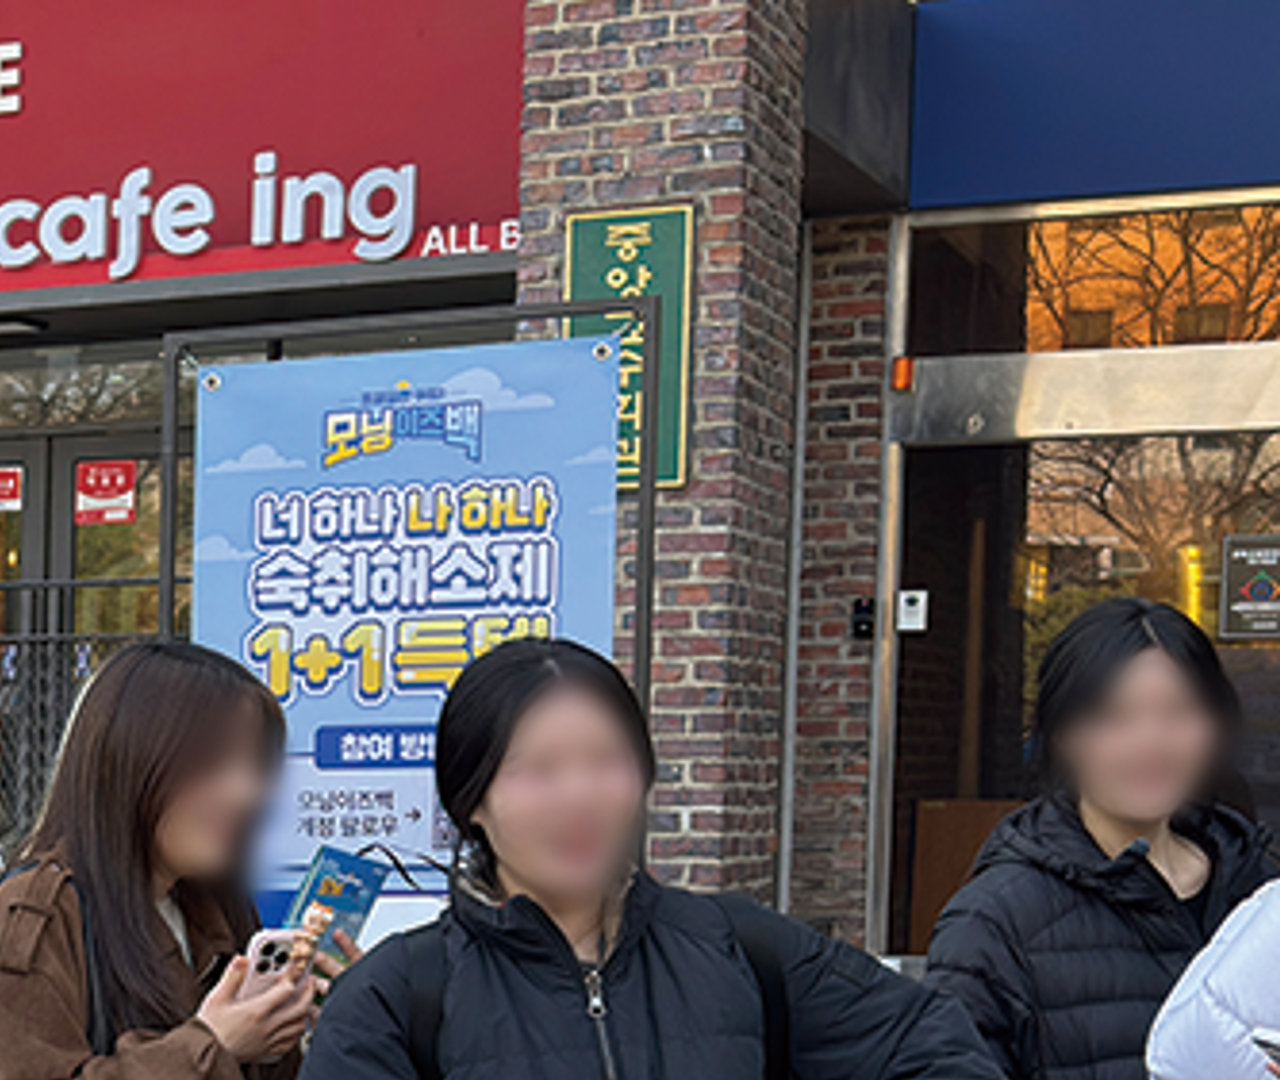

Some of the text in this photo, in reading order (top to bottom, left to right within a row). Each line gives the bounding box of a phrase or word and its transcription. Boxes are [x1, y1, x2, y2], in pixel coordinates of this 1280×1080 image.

[249, 152, 417, 260] ing
[420, 221, 490, 258] ALL
[321, 399, 482, 468] 모닝이즈백
[258, 477, 553, 543] 너 하나 나 하나
[252, 541, 553, 616] 숙취해소제
[250, 617, 388, 702] 1+1
[340, 732, 438, 761] 참여 방
[298, 789, 395, 812] 모닝이즈백
